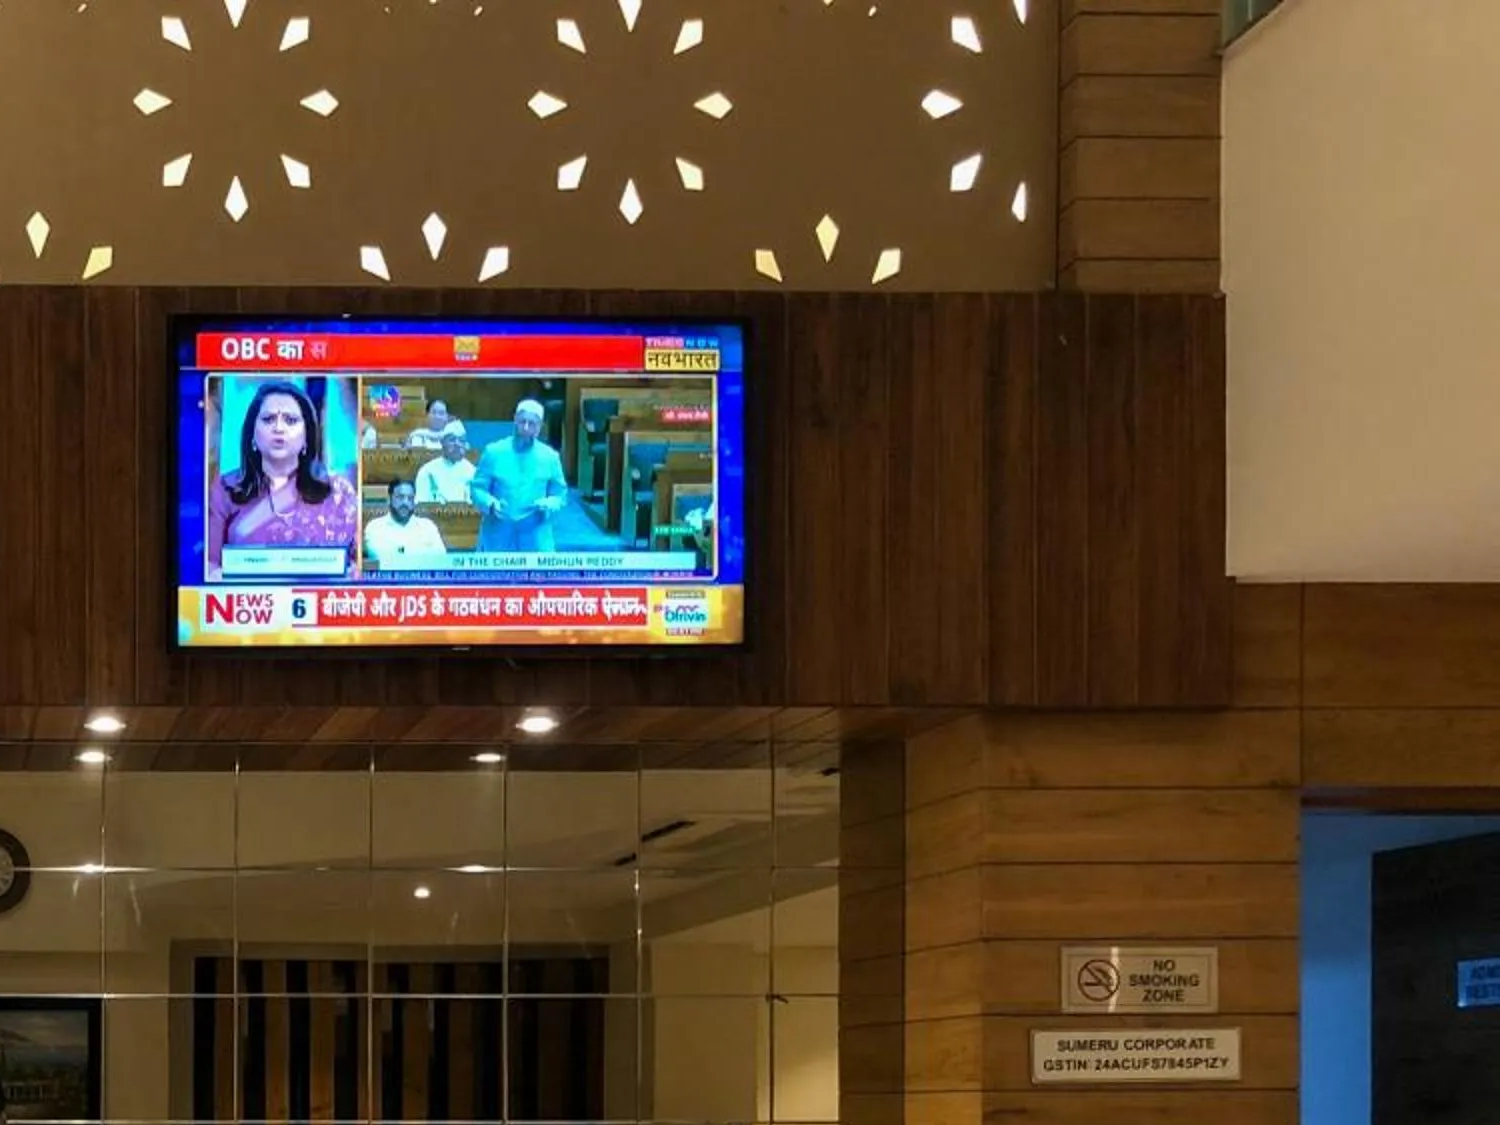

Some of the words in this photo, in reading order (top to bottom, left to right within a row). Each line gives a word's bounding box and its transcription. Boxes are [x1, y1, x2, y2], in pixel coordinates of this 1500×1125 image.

[221, 337, 271, 361] OBC
[277, 340, 304, 361] का
[647, 351, 718, 369] नवभारत
[452, 557, 465, 567] IN
[469, 557, 489, 567] THE
[492, 557, 527, 567] CHAIR
[537, 556, 583, 567] MIDHUN
[292, 599, 306, 619] 6
[370, 589, 397, 617] और
[399, 595, 426, 622] JDS
[430, 590, 445, 617] के
[448, 592, 501, 617] गठबंधन
[504, 596, 524, 617] का
[1153, 959, 1176, 972] NO
[1128, 974, 1200, 988] SMOKING
[1142, 989, 1186, 1003] ZONE
[1057, 1039, 1119, 1052] SUMERU
[1123, 1037, 1216, 1051] CORPORATE
